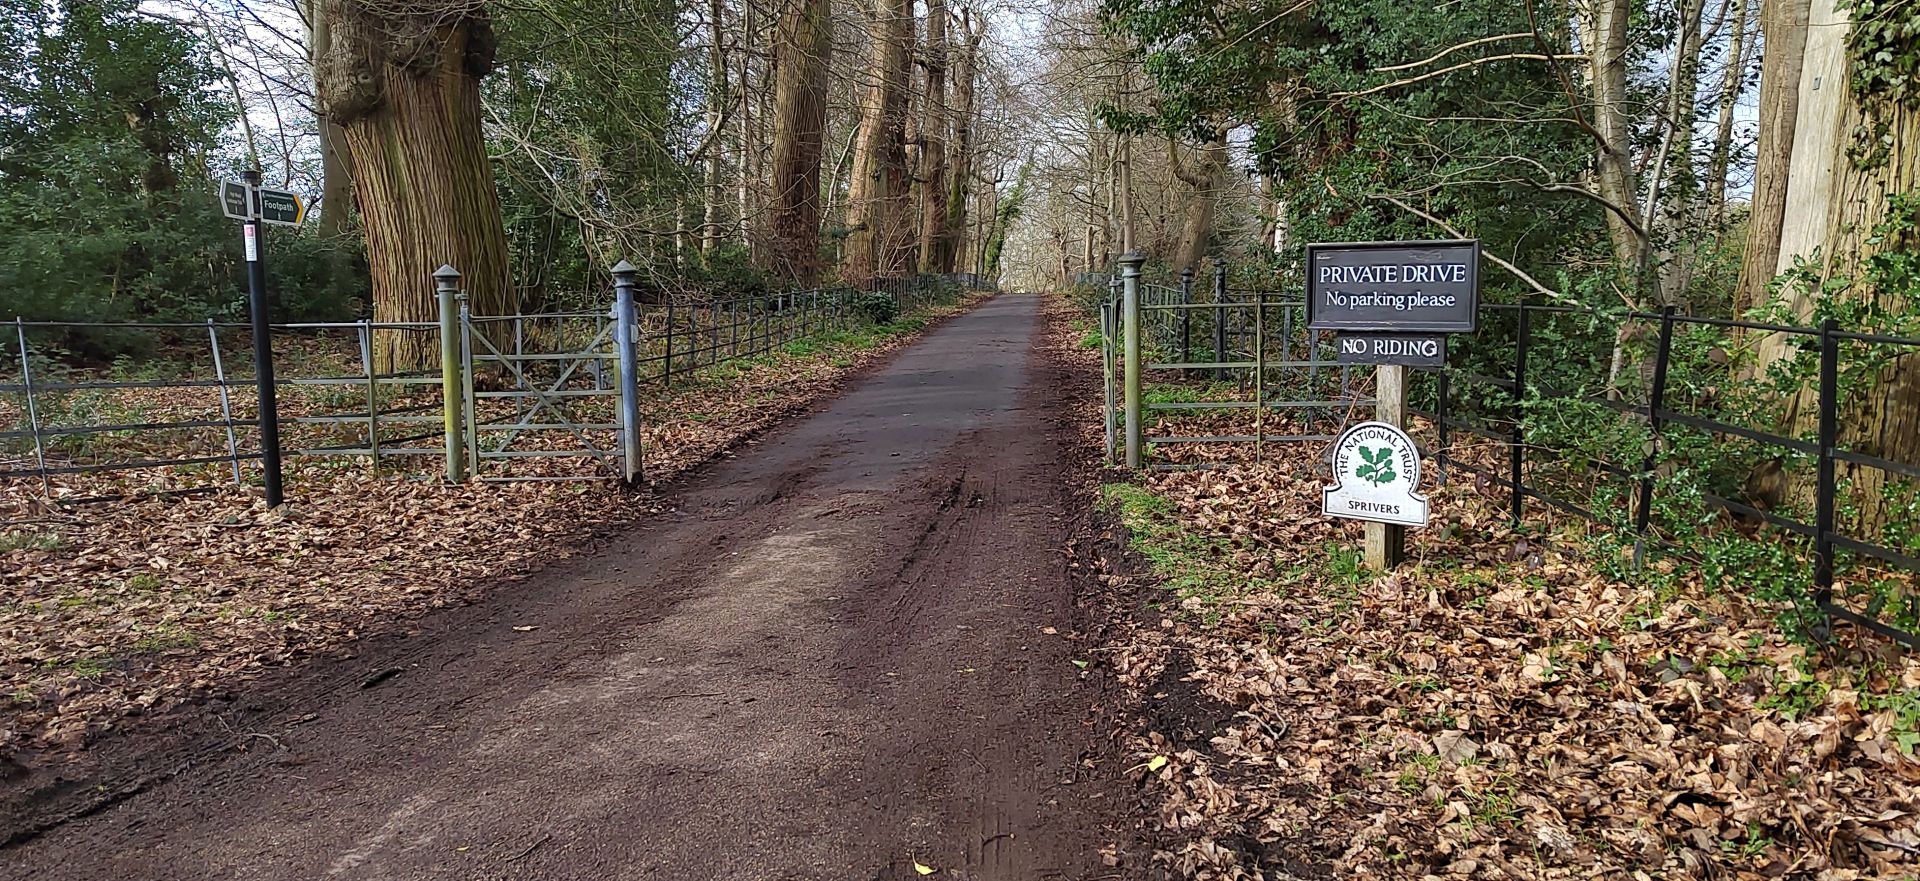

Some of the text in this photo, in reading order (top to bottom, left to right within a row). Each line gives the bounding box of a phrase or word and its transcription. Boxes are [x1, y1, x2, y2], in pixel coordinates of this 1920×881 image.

[264, 200, 294, 212] Footpath
[1319, 264, 1466, 283] PRIVATE DRIVE
[1325, 291, 1455, 311] No parking please
[1341, 338, 1438, 357] NO RIDING
[1339, 429, 1412, 483] THE NATIONAL TRUST
[1348, 500, 1400, 515] SPRIVERS
